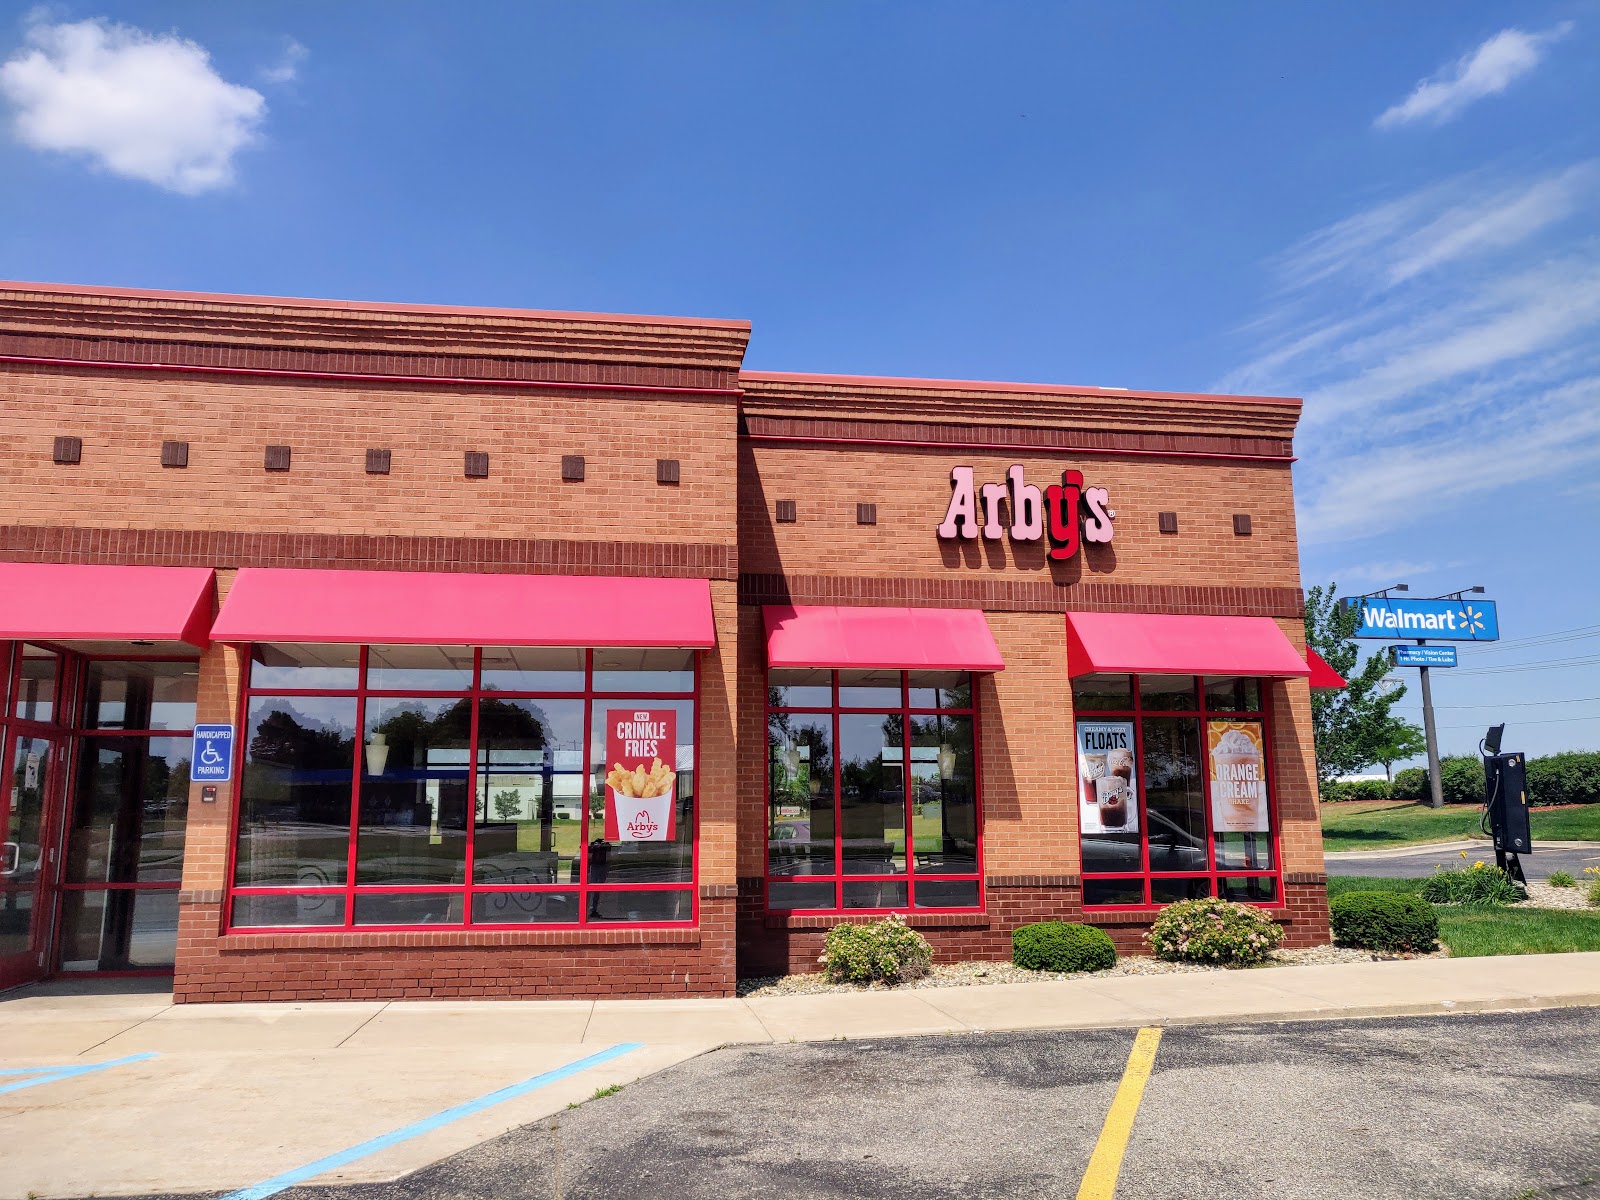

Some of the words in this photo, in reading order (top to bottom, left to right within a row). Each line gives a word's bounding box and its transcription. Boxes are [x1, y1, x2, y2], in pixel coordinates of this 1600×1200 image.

[937, 464, 1114, 559] Arby's
[1363, 608, 1456, 629] Walmart
[616, 722, 666, 739] CRINKLE
[625, 740, 658, 757] FRIES
[1085, 732, 1126, 750] FLOATS
[198, 766, 224, 774] PARKING
[1216, 764, 1259, 780] ORANGE
[1220, 782, 1258, 798] CREAM
[626, 822, 658, 832] Arby's
